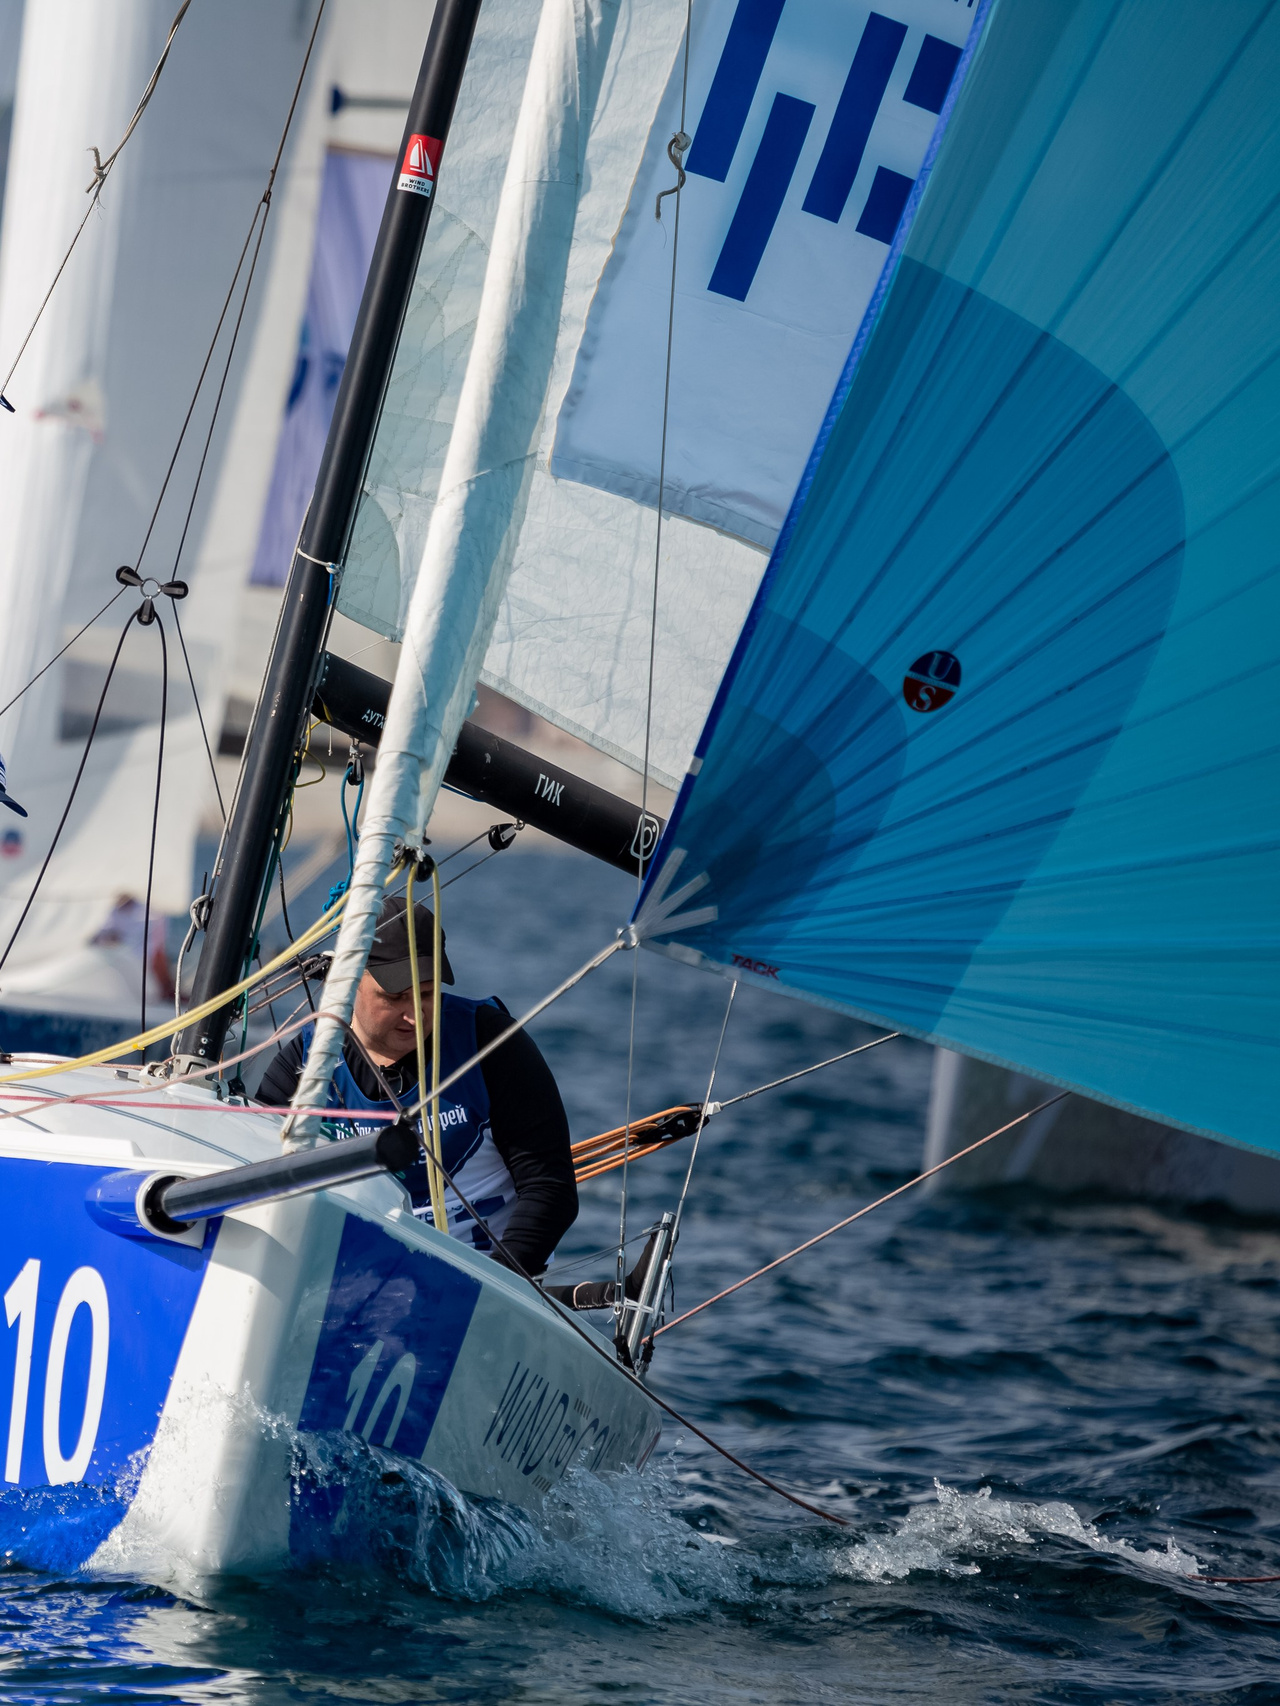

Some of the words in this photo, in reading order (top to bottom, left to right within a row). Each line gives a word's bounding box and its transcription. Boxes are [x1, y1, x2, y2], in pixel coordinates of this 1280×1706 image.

[401, 182, 430, 194] BROTHERS
[409, 178, 426, 187] WIND
[534, 773, 565, 807] ГИК
[732, 953, 782, 981] TACK
[4, 1258, 110, 1486] 10
